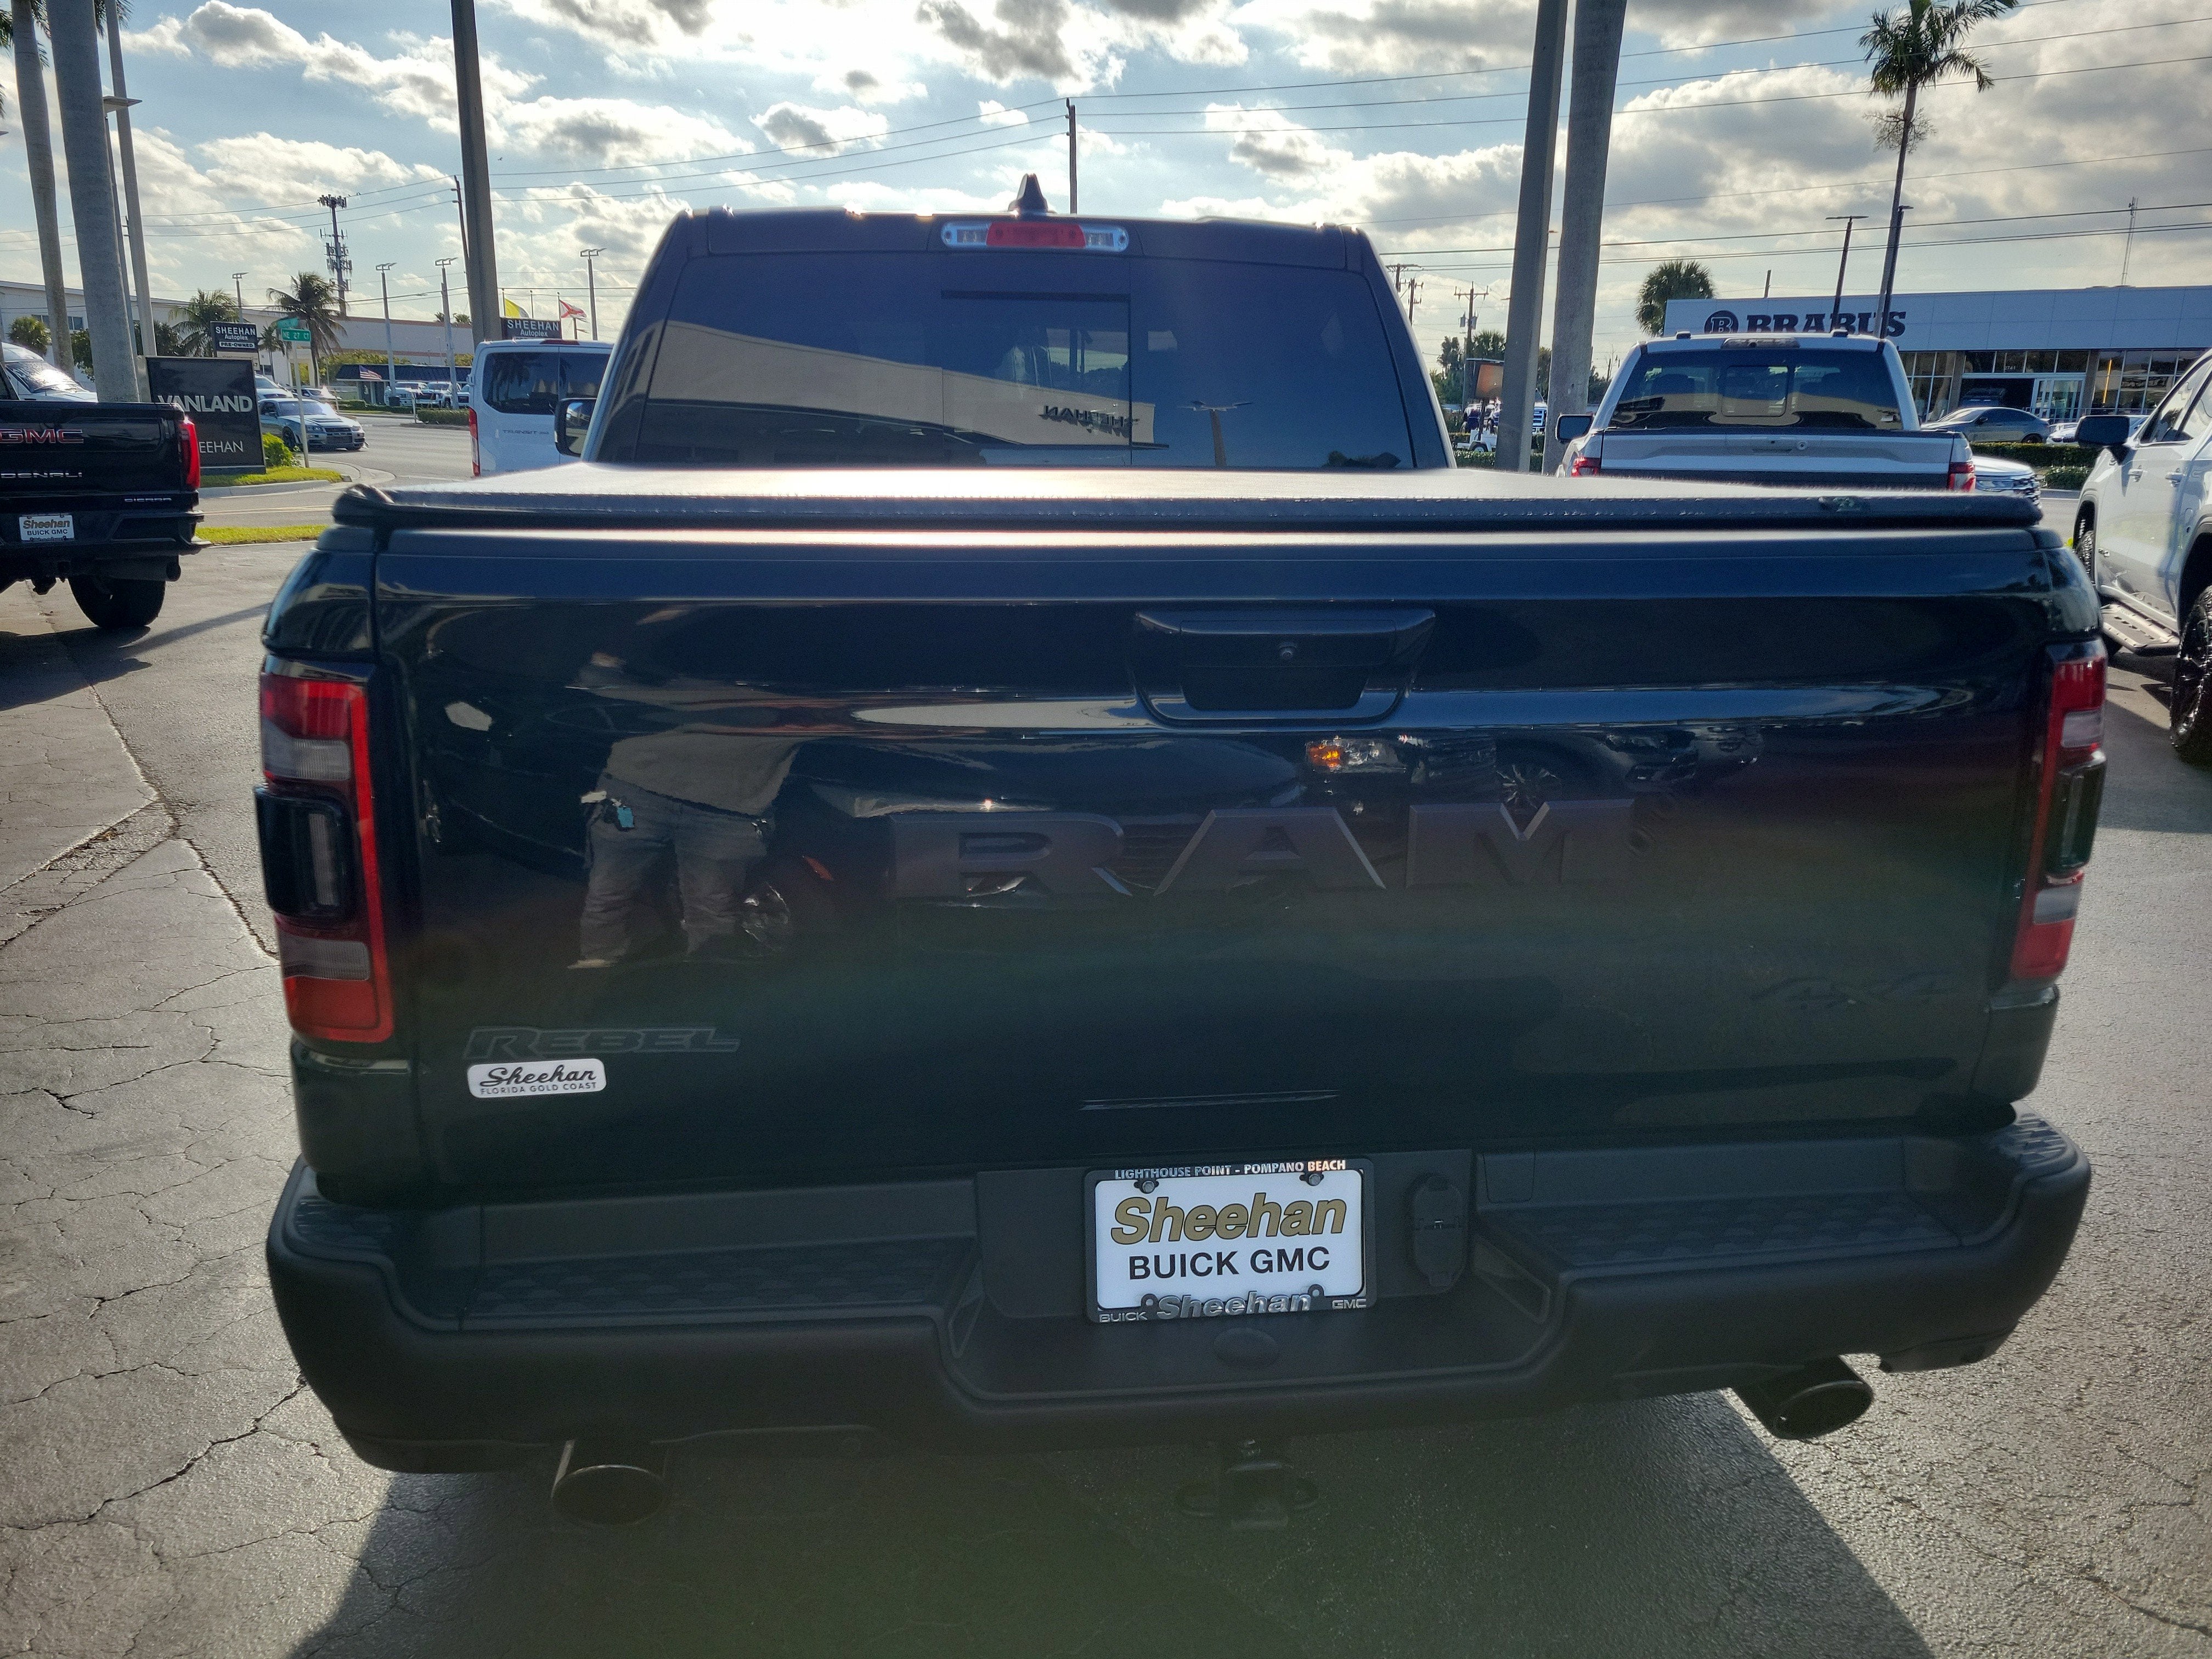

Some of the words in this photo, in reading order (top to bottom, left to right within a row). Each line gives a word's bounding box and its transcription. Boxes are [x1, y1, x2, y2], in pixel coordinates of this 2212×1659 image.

[216, 326, 256, 335] SHEEHAN
[507, 319, 559, 331] SHEEHAN
[1747, 311, 1906, 337] BRABUS
[0, 428, 83, 444] GMC
[23, 519, 70, 529] Sheehan
[888, 798, 1636, 900] RAM
[462, 1025, 741, 1060] REBEL
[480, 1064, 596, 1087] Sheehan
[480, 1086, 525, 1095] FLORIDA
[530, 1084, 558, 1092] GOLD
[563, 1081, 597, 1091] COAST
[1115, 1166, 1190, 1180] LIGHTHOUSE
[1195, 1165, 1231, 1177] POINT
[1244, 1161, 1304, 1174] POMPANO
[1307, 1160, 1346, 1172] BEACH
[1110, 1192, 1347, 1245] Sheehan
[1129, 1251, 1239, 1280] BUICK
[1250, 1246, 1330, 1273] GMC
[1099, 1311, 1148, 1323] BUICK
[1156, 1291, 1311, 1319] Sheehan
[1332, 1298, 1367, 1310] GMC
